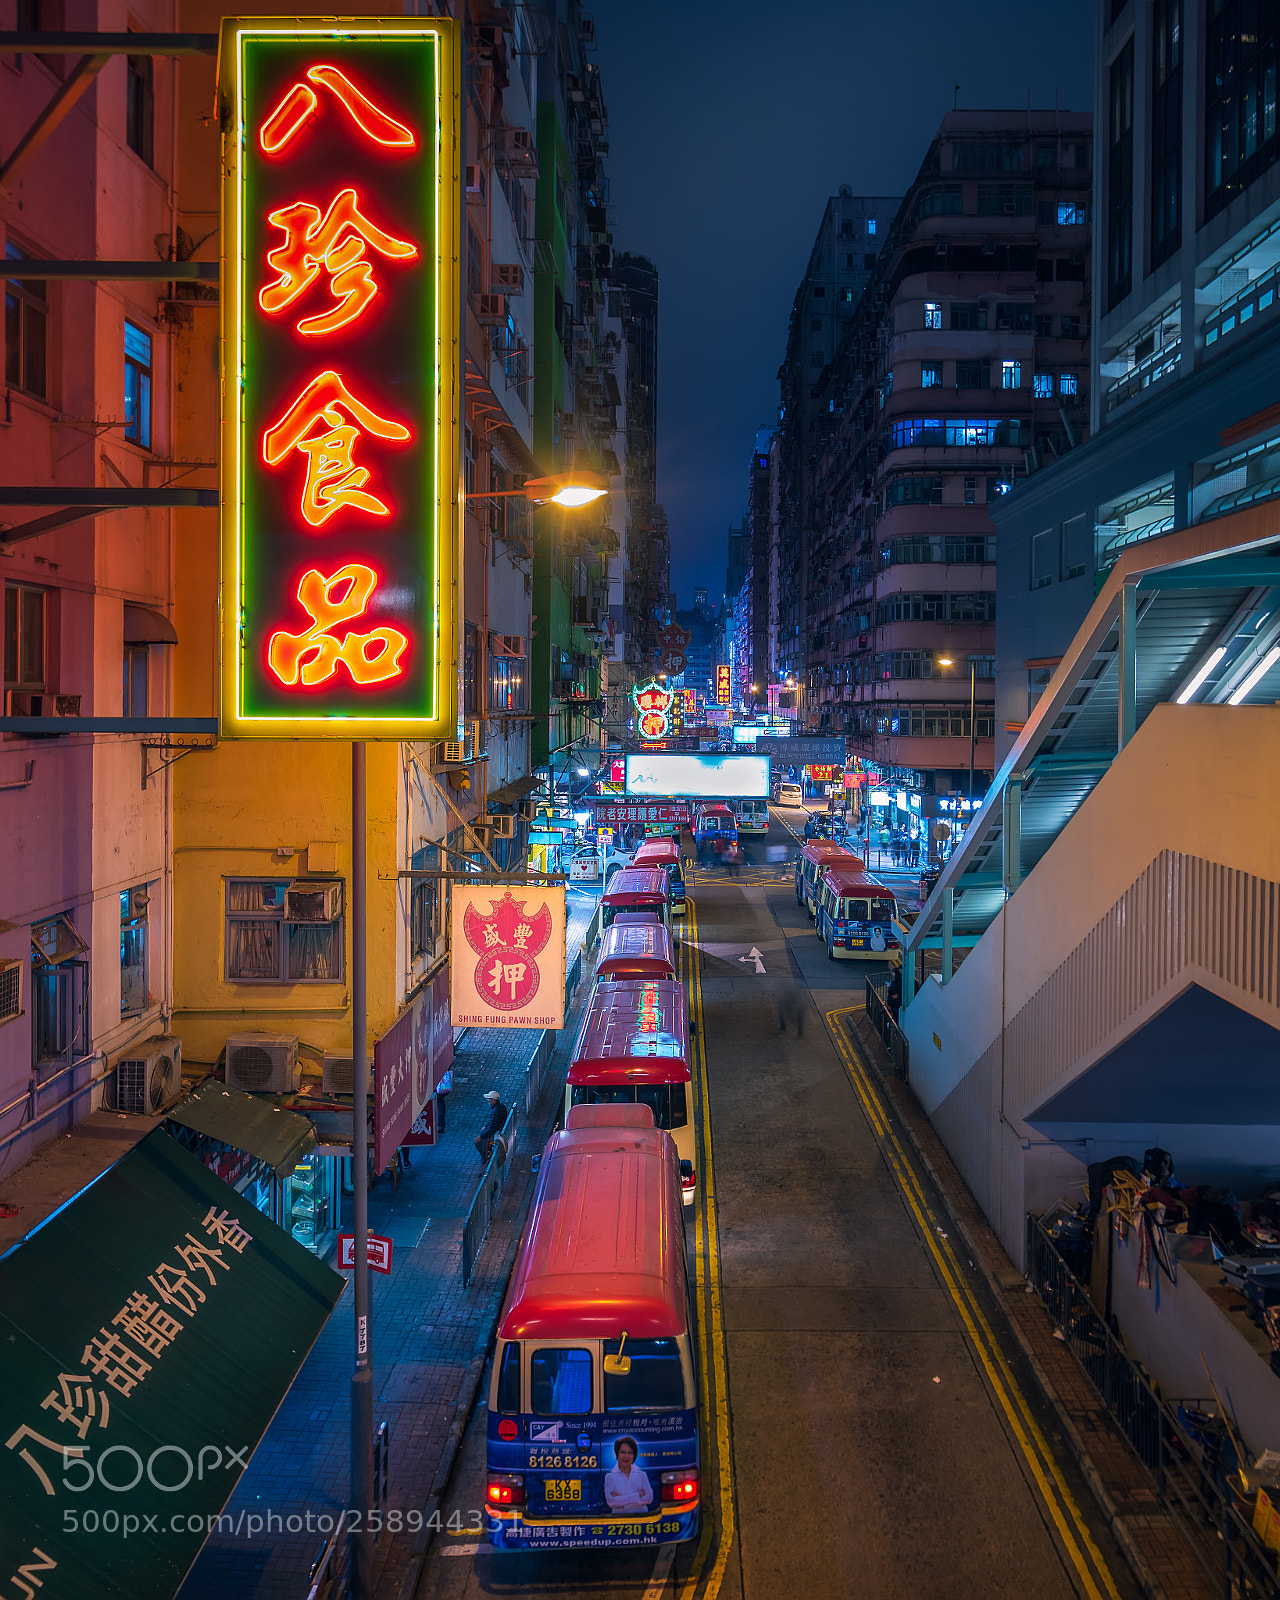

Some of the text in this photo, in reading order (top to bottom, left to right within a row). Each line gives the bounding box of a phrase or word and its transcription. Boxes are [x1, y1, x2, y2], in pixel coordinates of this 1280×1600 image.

[258, 65, 419, 687] 八珍食品
[665, 653, 683, 671] 押
[643, 713, 664, 735] 押
[488, 959, 527, 1000] 押
[458, 1014, 556, 1025] SHING FUNG PAWN SHOP
[5, 1206, 254, 1496] 八珍甜醋份外香
[529, 1456, 597, 1468] 8126 8126
[555, 1480, 571, 1491] KX
[547, 1490, 580, 1499] 6358
[505, 1522, 680, 1539] 高捷廣告製作 2730 6138
[529, 1536, 658, 1548] www.speedup.com.hk
